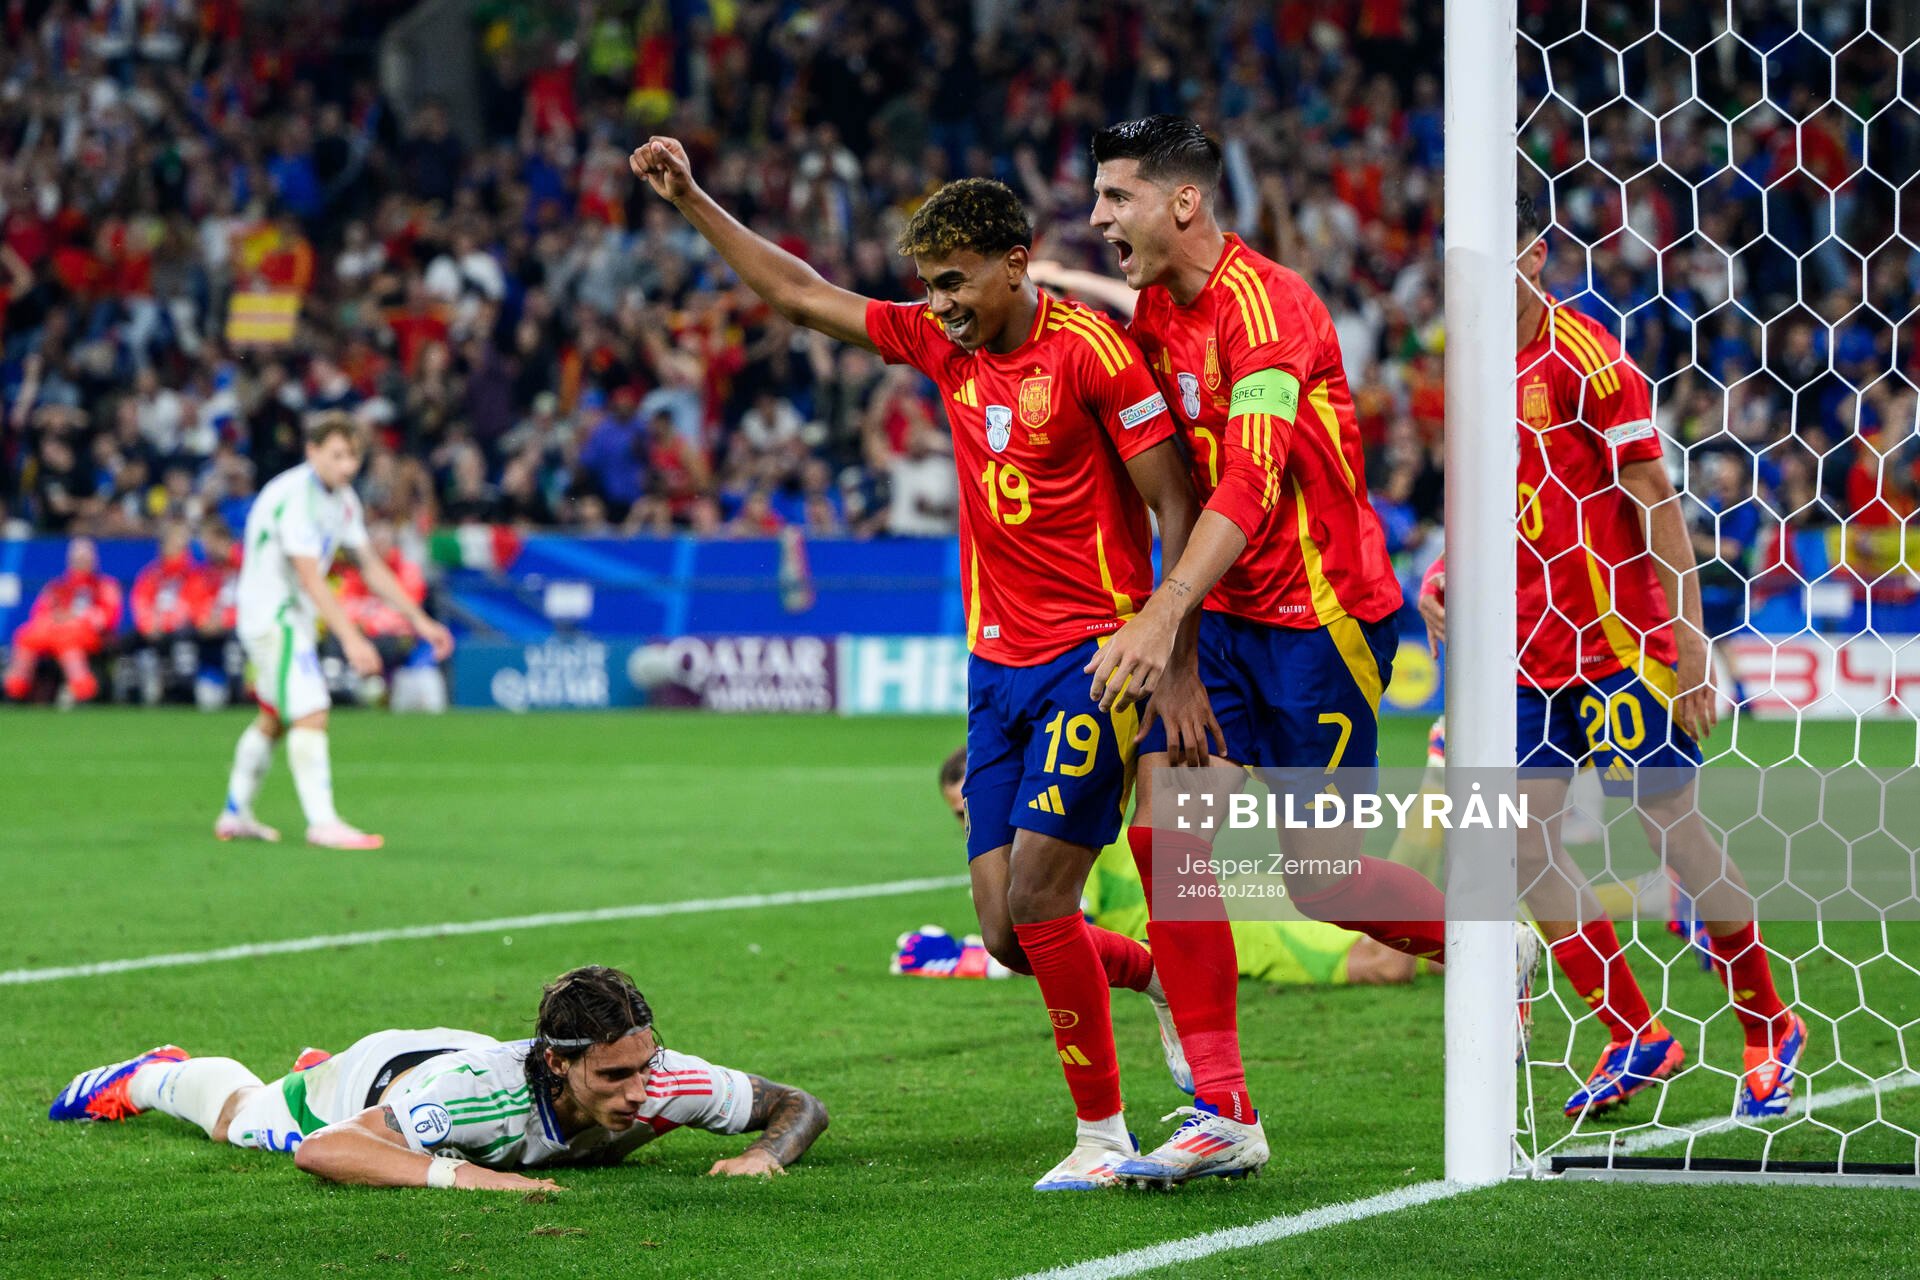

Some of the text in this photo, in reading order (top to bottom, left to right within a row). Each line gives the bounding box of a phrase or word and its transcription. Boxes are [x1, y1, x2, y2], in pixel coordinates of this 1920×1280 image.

[1232, 388, 1265, 403] SPECT
[1194, 426, 1218, 488] 7
[981, 460, 1032, 525] 19
[1516, 482, 1545, 541] 0
[1044, 710, 1101, 778] 19
[1317, 712, 1353, 775] 7
[1580, 691, 1646, 752] 20
